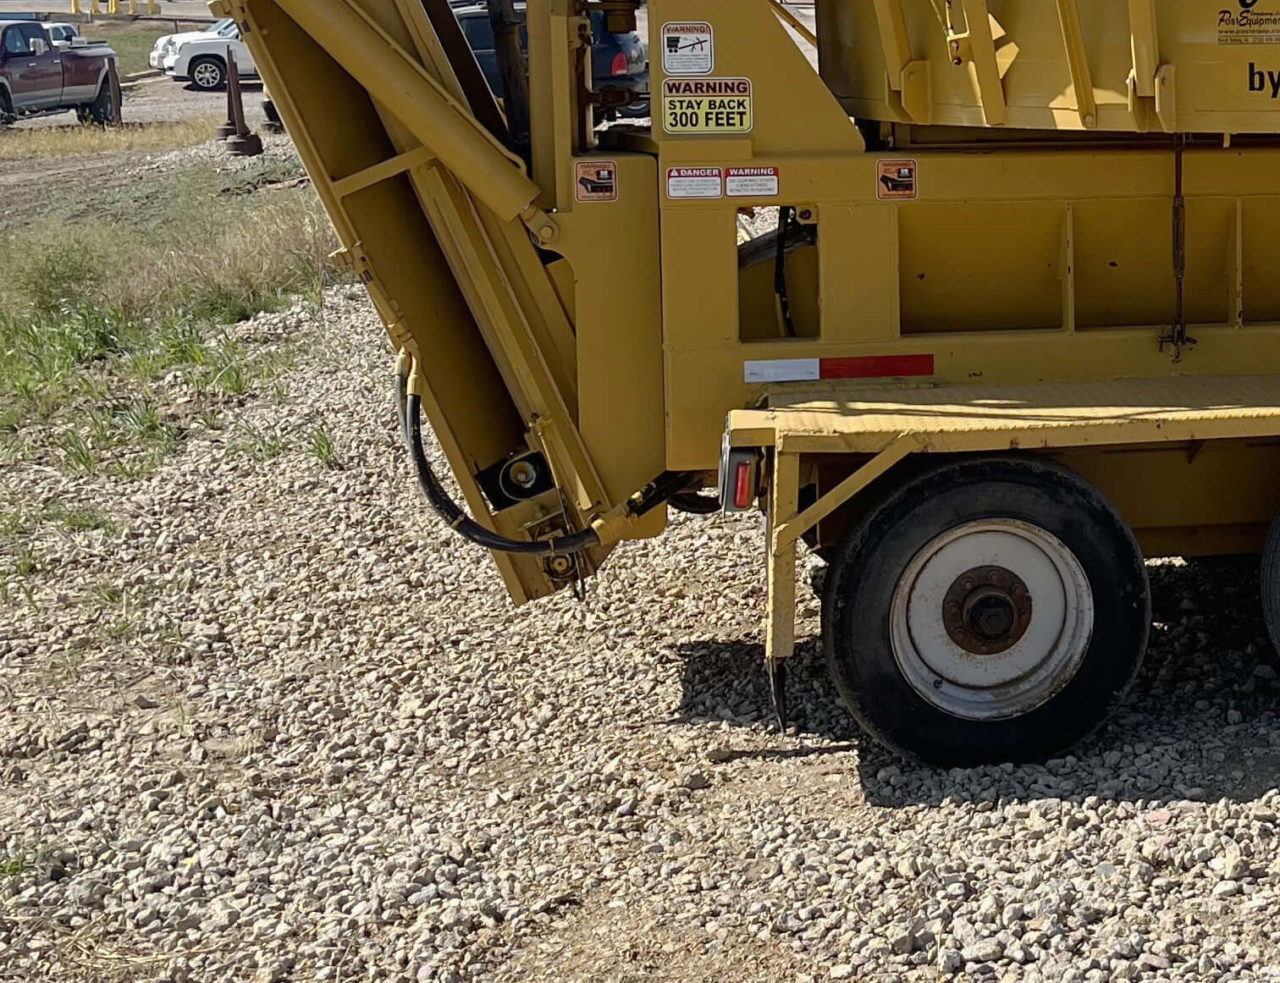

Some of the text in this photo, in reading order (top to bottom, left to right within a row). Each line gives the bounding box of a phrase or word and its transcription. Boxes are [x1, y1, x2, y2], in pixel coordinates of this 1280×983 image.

[667, 82, 748, 94] WARNING
[668, 99, 746, 110] STAY BACK
[669, 111, 747, 127] 300 FEET
